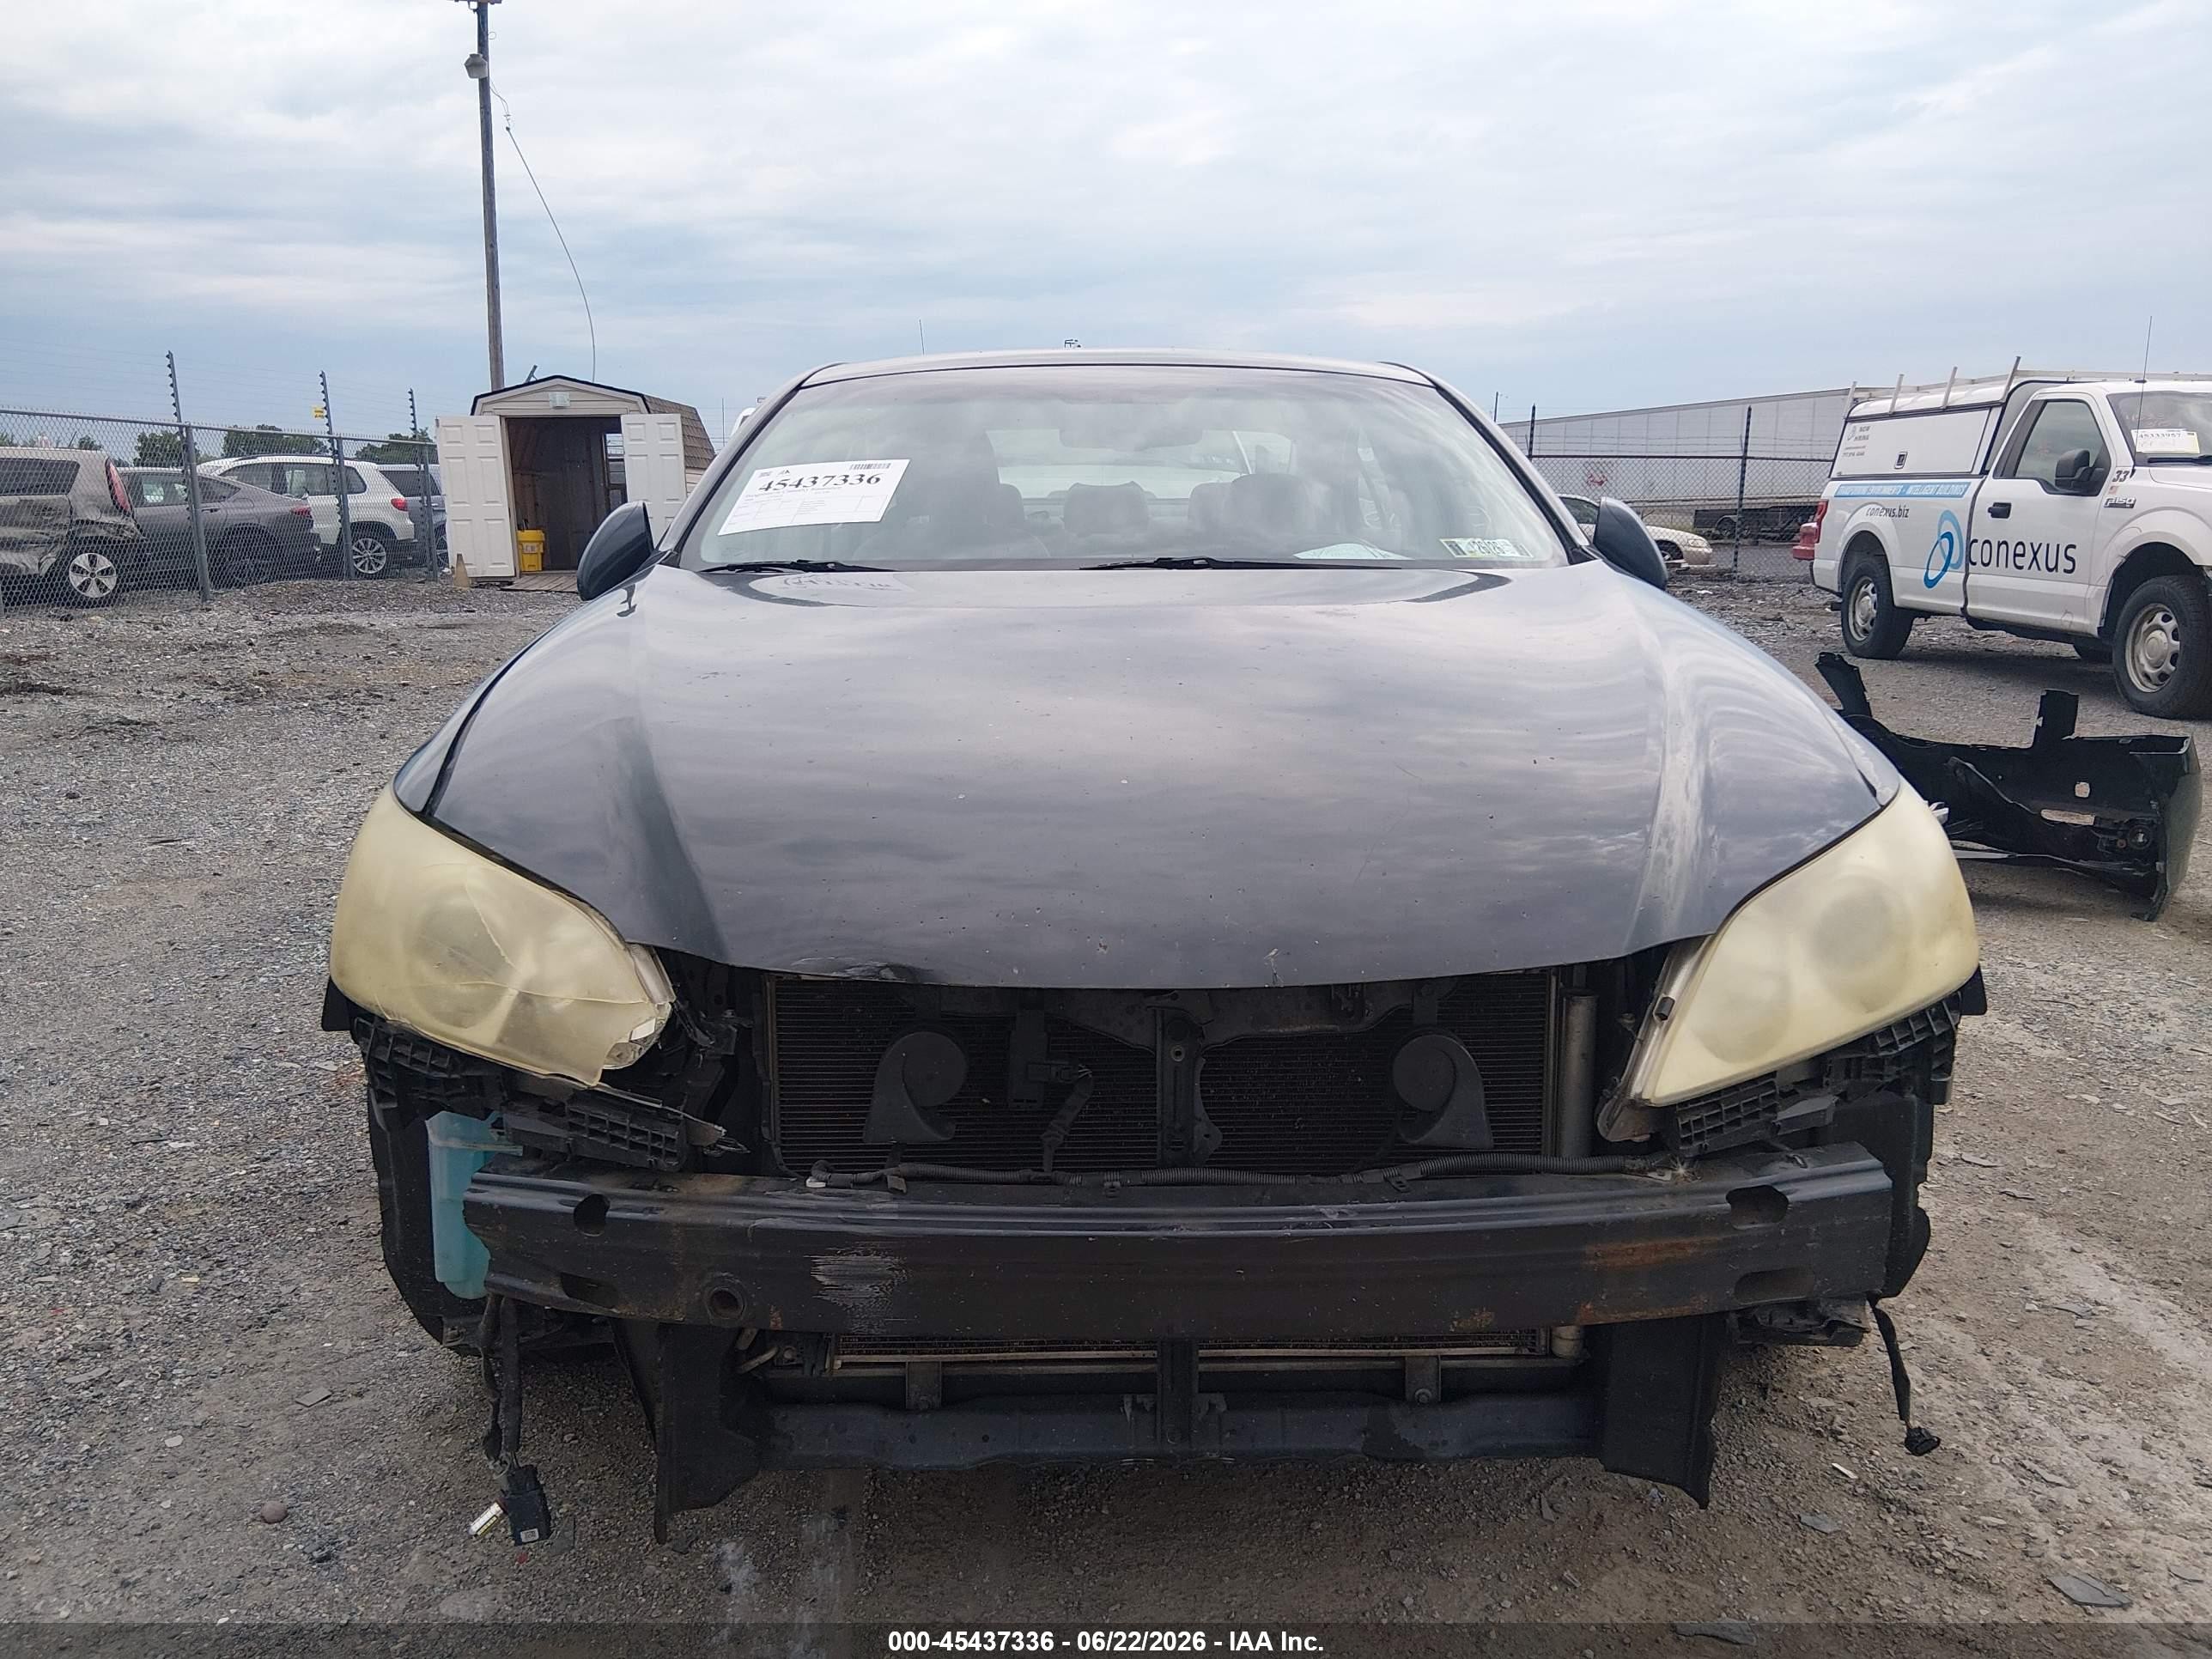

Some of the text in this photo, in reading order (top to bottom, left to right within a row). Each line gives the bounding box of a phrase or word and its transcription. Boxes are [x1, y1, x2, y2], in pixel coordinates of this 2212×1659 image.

[758, 473, 884, 492] 45437336
[2112, 470, 2130, 483] 33
[1865, 504, 1910, 518] conexus.biz
[1968, 538, 2077, 574] conexus
